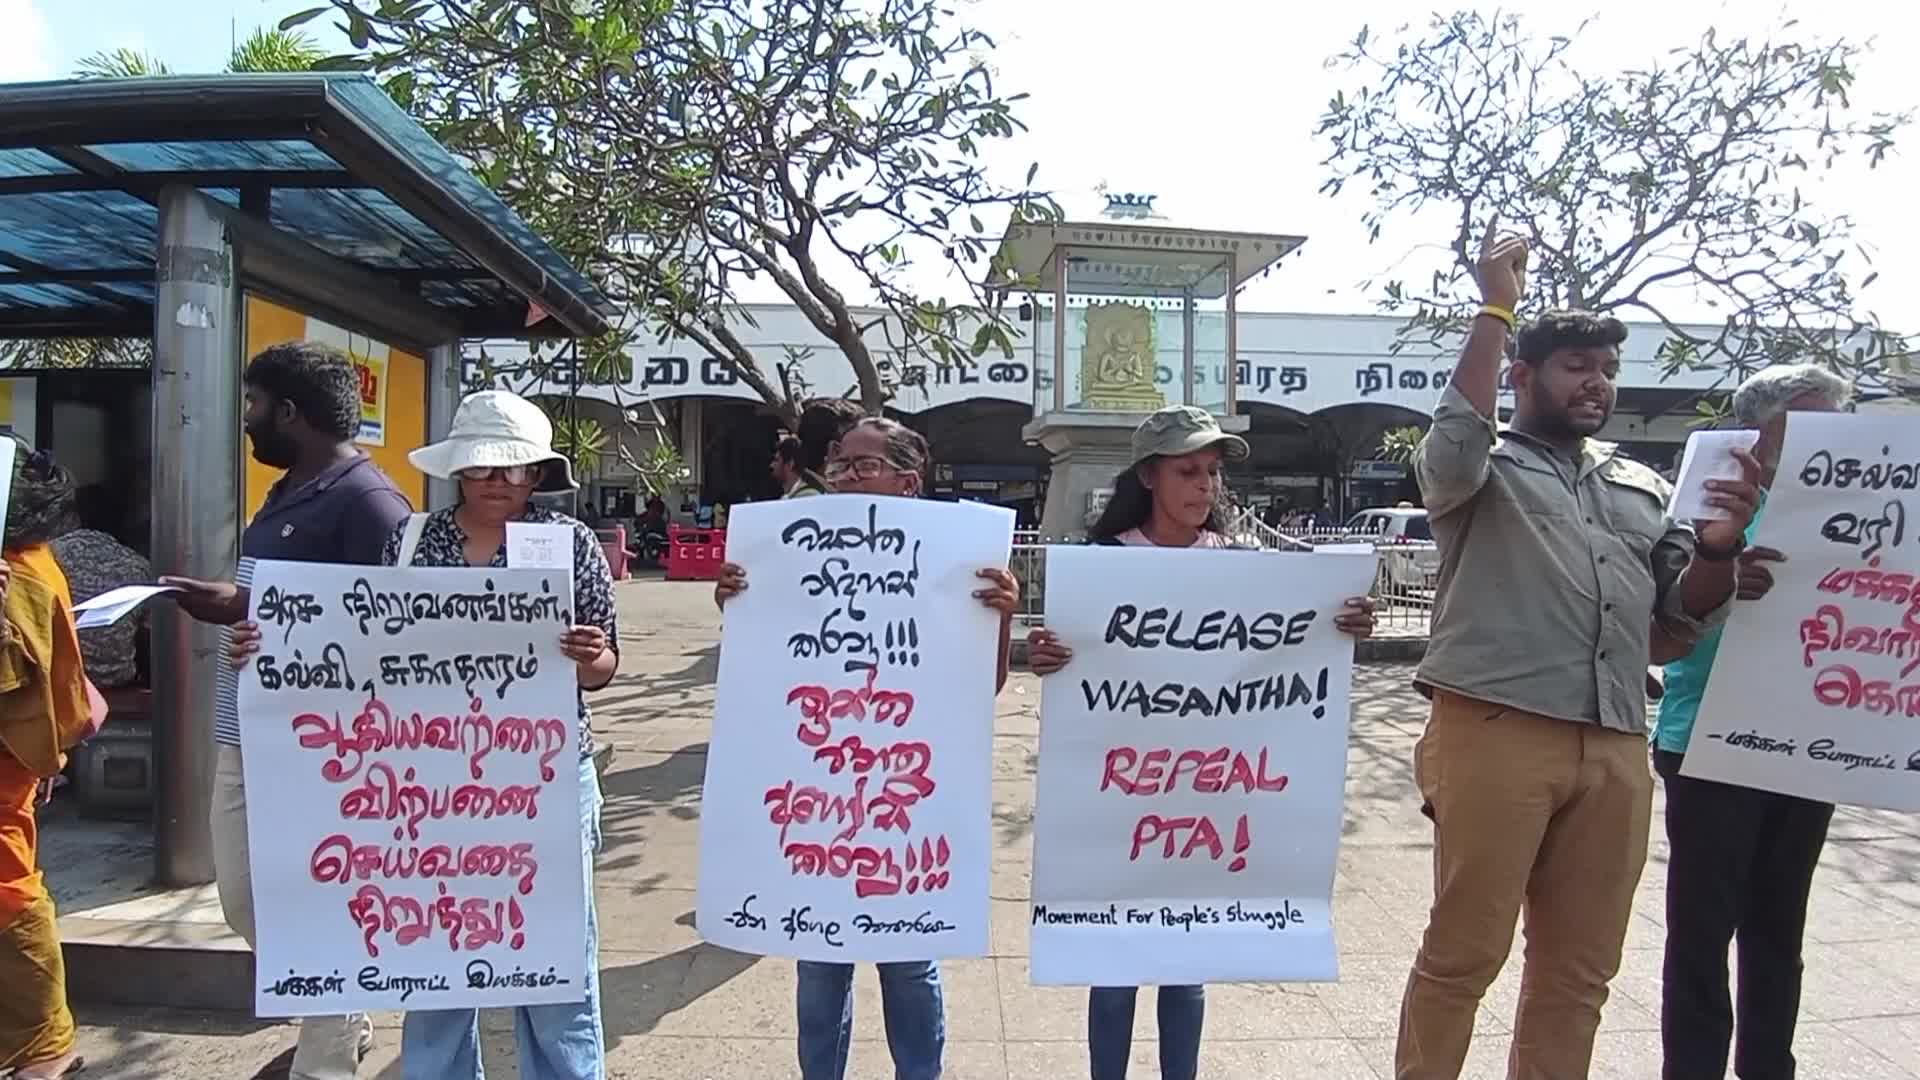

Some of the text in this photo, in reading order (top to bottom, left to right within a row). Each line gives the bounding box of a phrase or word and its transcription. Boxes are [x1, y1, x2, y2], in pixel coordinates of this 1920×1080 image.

[1105, 604, 1316, 651] RELEASE
[1081, 667, 1328, 719] WASANTHA!
[292, 696, 566, 782] ஆகியவற்றை
[1100, 747, 1288, 795] REPEAL
[341, 761, 541, 840] விற்பனை
[310, 827, 538, 894] செய்வதை
[1130, 814, 1250, 872] PTA!
[1032, 900, 1304, 932] Movement For People's Struggle
